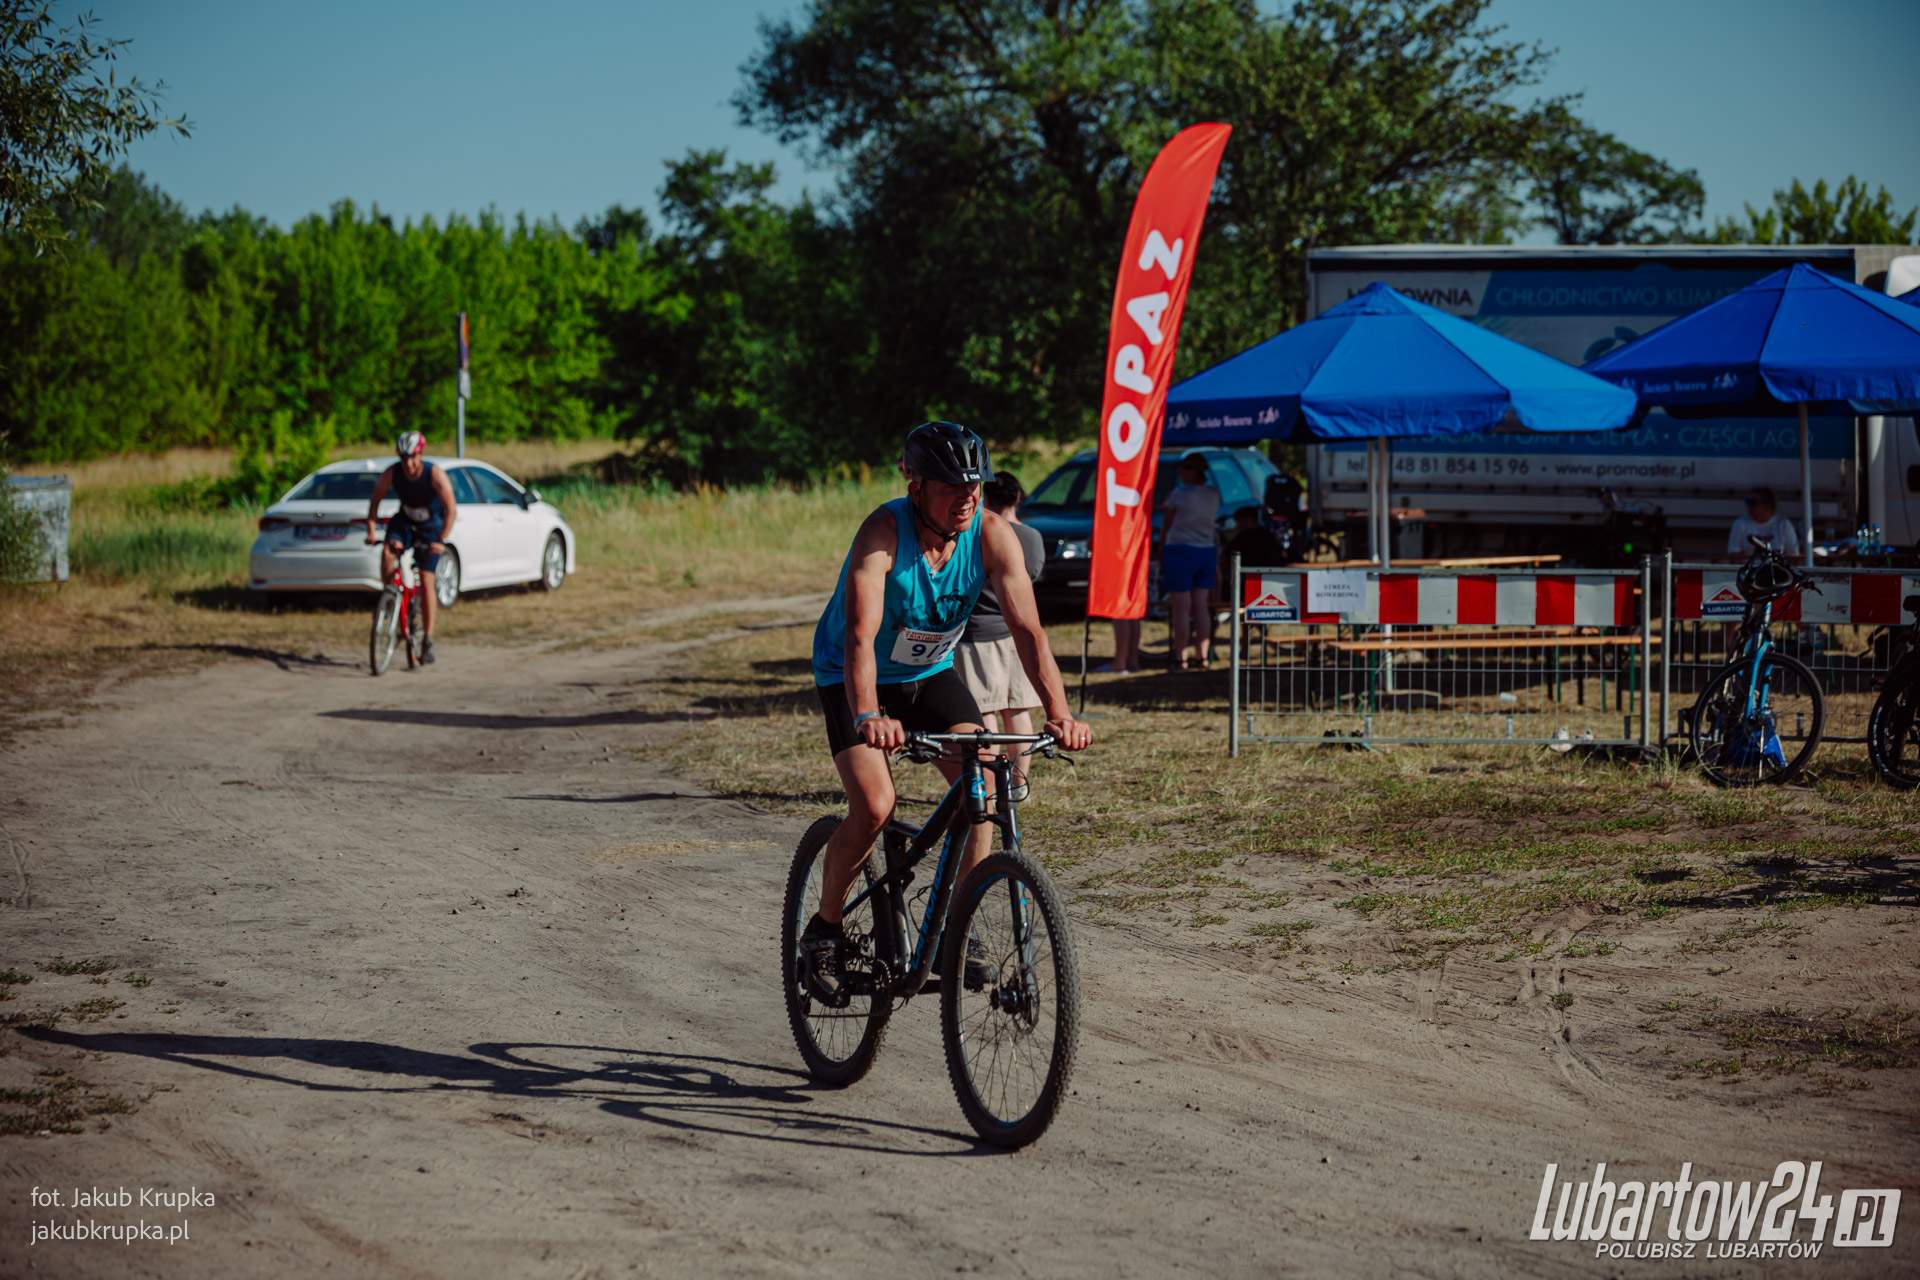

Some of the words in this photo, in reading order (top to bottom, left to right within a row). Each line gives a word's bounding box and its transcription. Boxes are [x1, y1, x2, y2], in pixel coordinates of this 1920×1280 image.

[1495, 287, 1658, 307] CHŁODNICTWO
[1106, 230, 1184, 517] TOPAZ
[1420, 459, 1439, 473] 81
[1446, 459, 1476, 475] 854
[1484, 459, 1503, 475] 15
[1508, 460, 1529, 476] 96
[1555, 461, 1696, 480] www.promaster.pl
